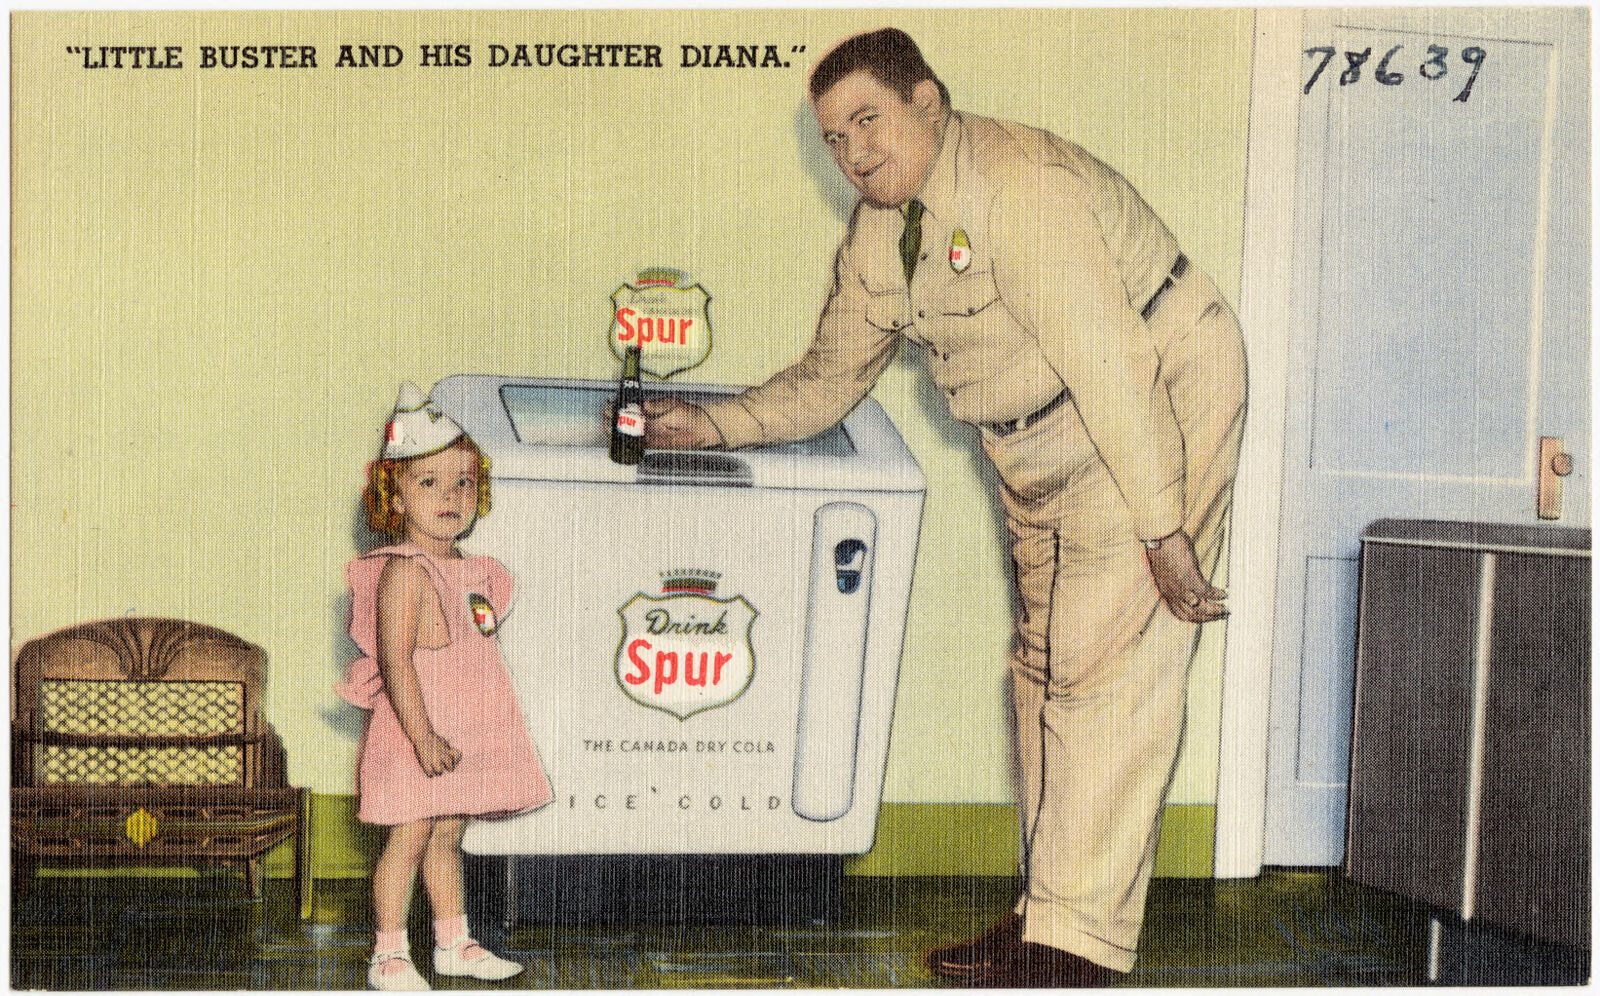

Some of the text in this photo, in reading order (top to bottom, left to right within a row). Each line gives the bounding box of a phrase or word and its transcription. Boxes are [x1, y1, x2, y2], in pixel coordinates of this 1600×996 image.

[1303, 43, 1487, 103] 78639
[616, 306, 694, 351] Spur
[645, 608, 729, 636] Drink
[624, 638, 733, 695] Spur
[583, 739, 776, 753] THE CANADA DRY COLA
[569, 794, 781, 811] ICE COLD
